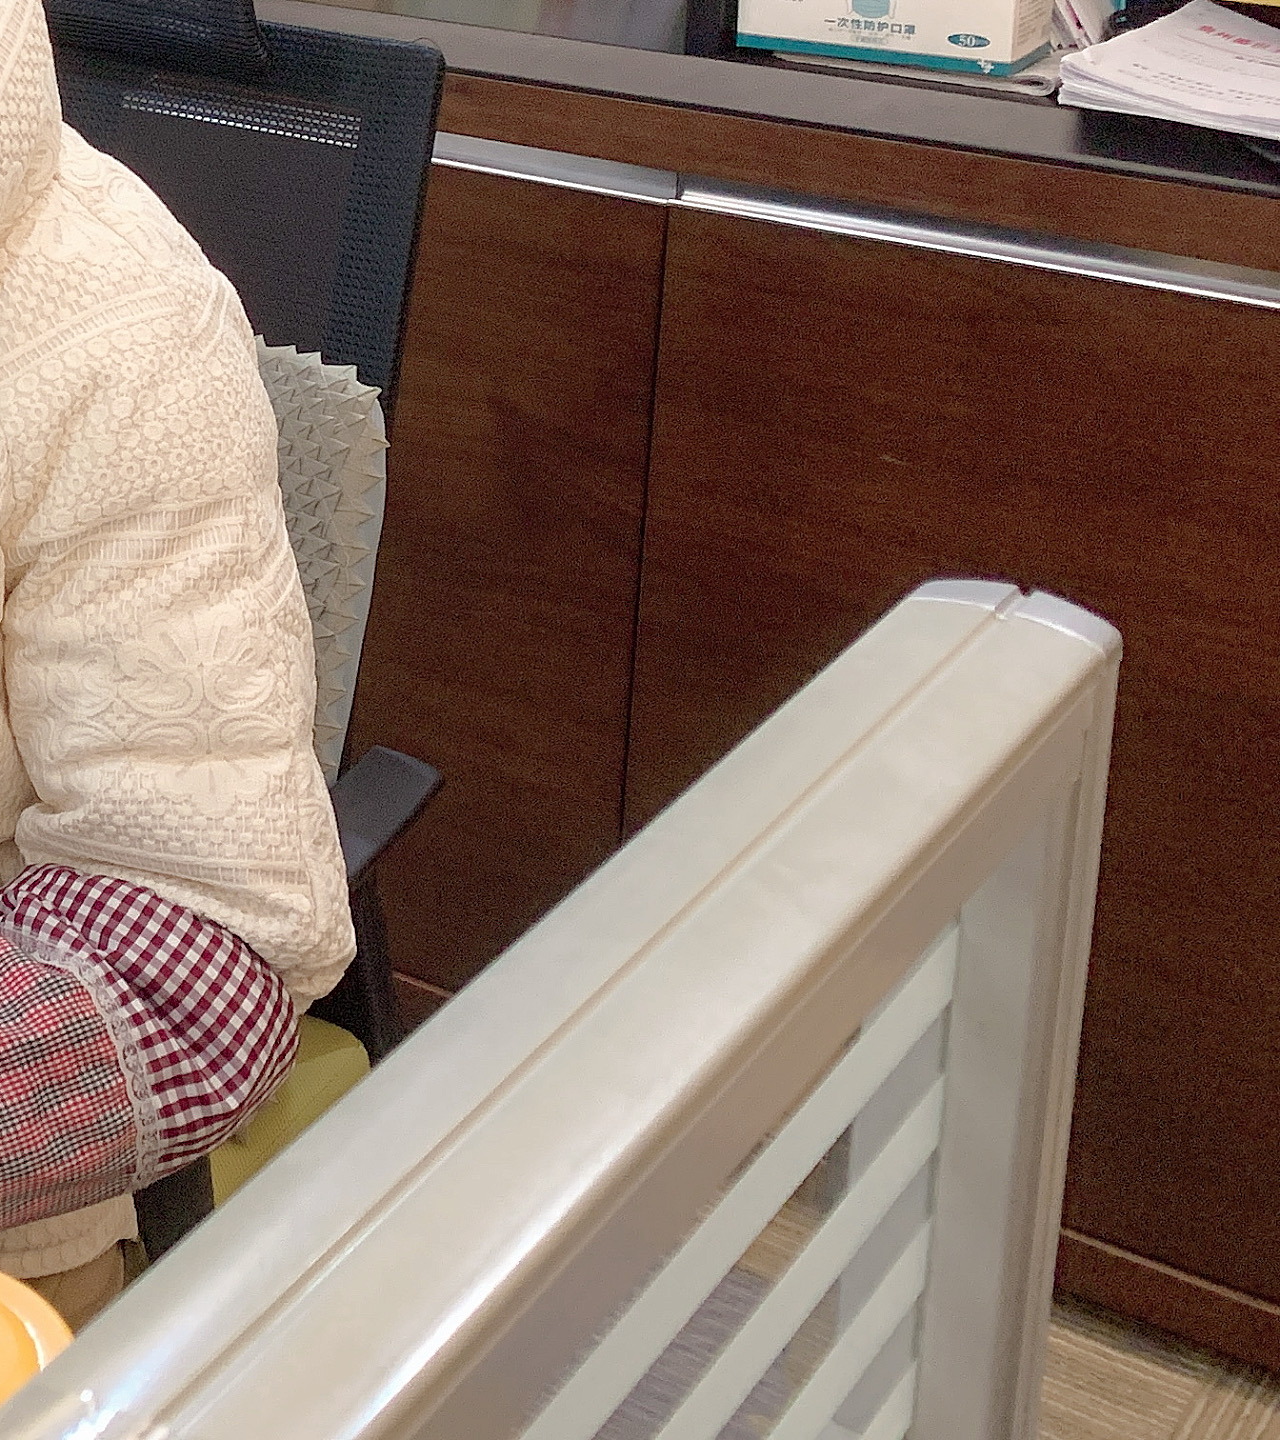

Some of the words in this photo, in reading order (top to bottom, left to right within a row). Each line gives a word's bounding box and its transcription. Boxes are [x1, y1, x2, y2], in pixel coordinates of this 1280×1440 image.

[824, 17, 916, 36] 一次性防护口罩
[958, 34, 977, 48] 50
